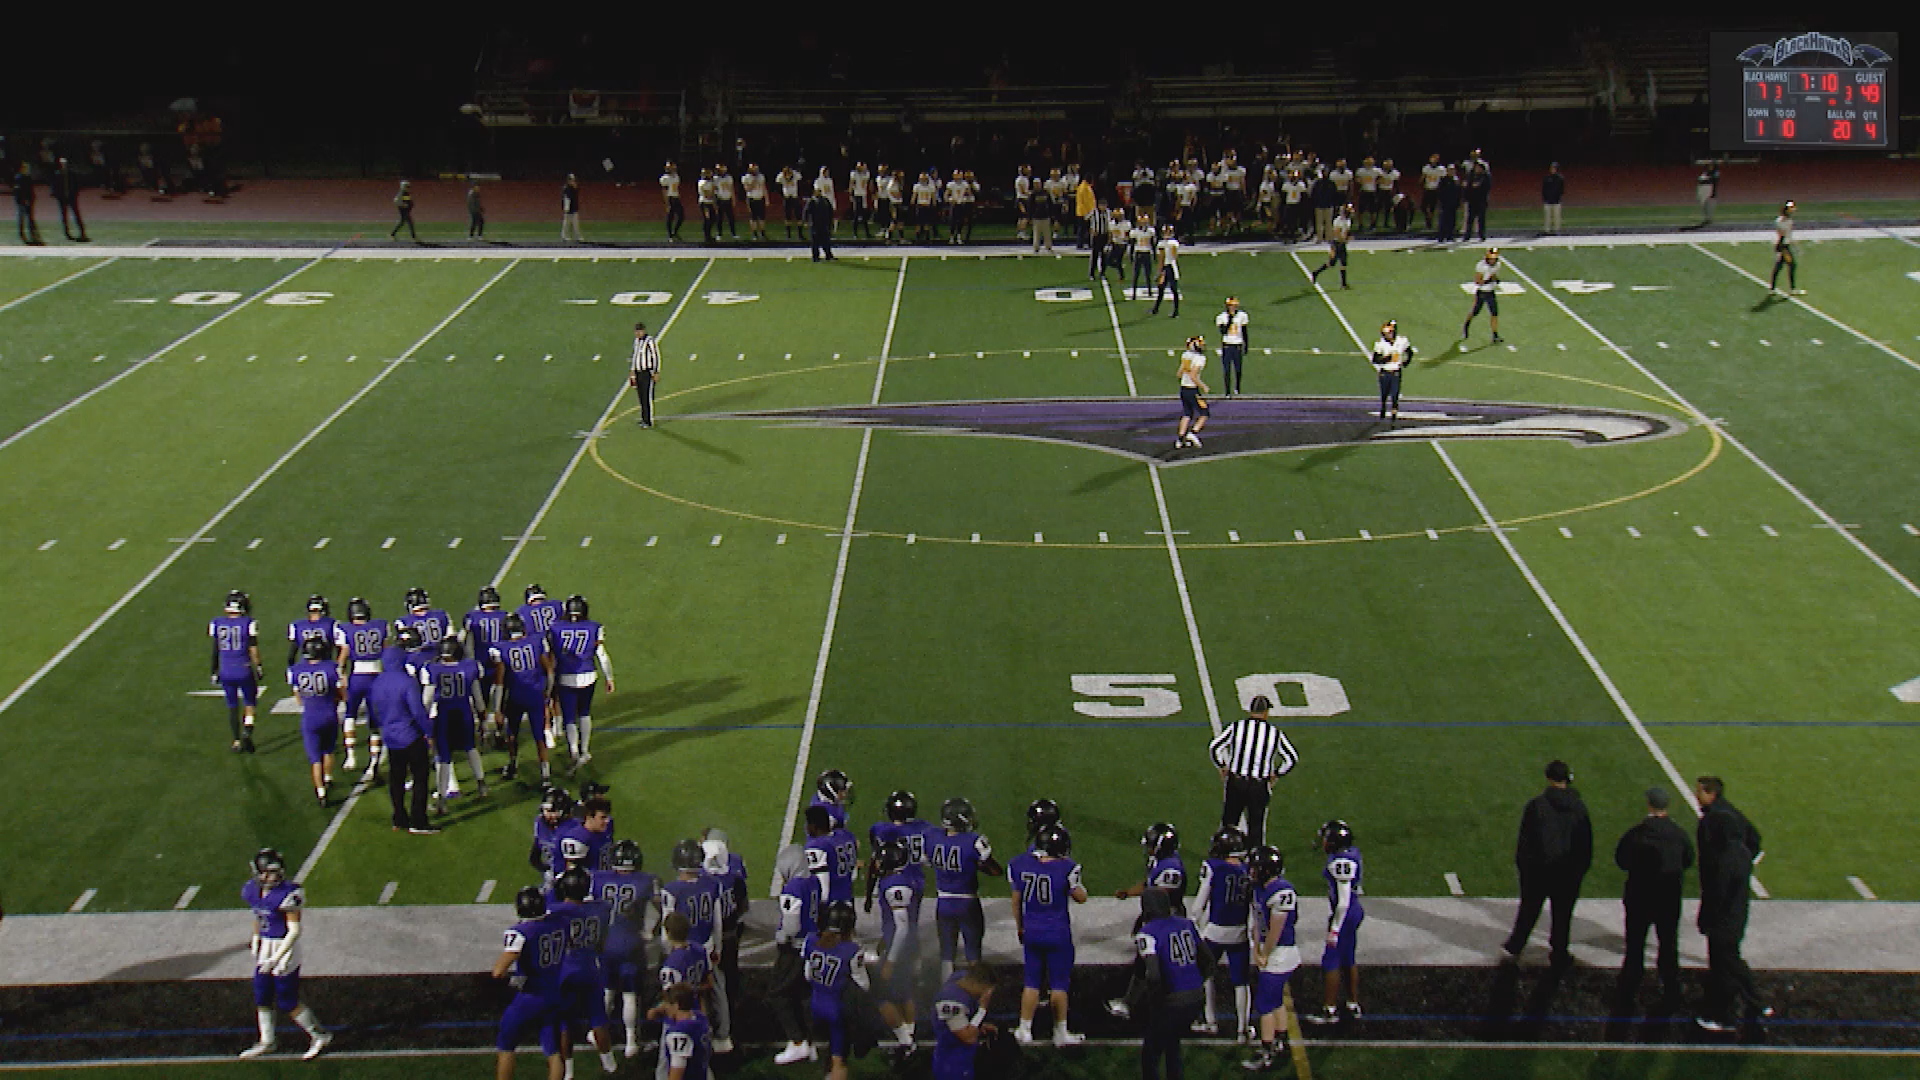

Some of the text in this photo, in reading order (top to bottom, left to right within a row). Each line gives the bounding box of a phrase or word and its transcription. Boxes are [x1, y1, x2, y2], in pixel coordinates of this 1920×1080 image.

[1801, 73, 1838, 92] 7:10
[1855, 73, 1884, 84] GUEST
[1757, 82, 1767, 100] 7
[1747, 108, 1769, 117] DOWN
[1775, 108, 1785, 118] TO
[1827, 110, 1856, 120] BALL ON
[1862, 110, 1878, 121] QTR
[1757, 120, 1765, 136] 1
[1781, 119, 1796, 138] 10
[1832, 120, 1851, 139] 20
[1864, 122, 1876, 139] 4
[216, 624, 242, 651] 21
[353, 629, 384, 657] 82
[560, 629, 590, 655] 77
[508, 644, 537, 673] 81
[299, 670, 330, 697] 20
[439, 671, 466, 699] 51
[1070, 673, 1351, 717] 50
[932, 843, 963, 873] 44
[1021, 871, 1053, 905] 70
[784, 899, 791, 911] 4
[538, 928, 565, 968] 87
[1167, 929, 1197, 967] 40
[810, 951, 843, 987] 27
